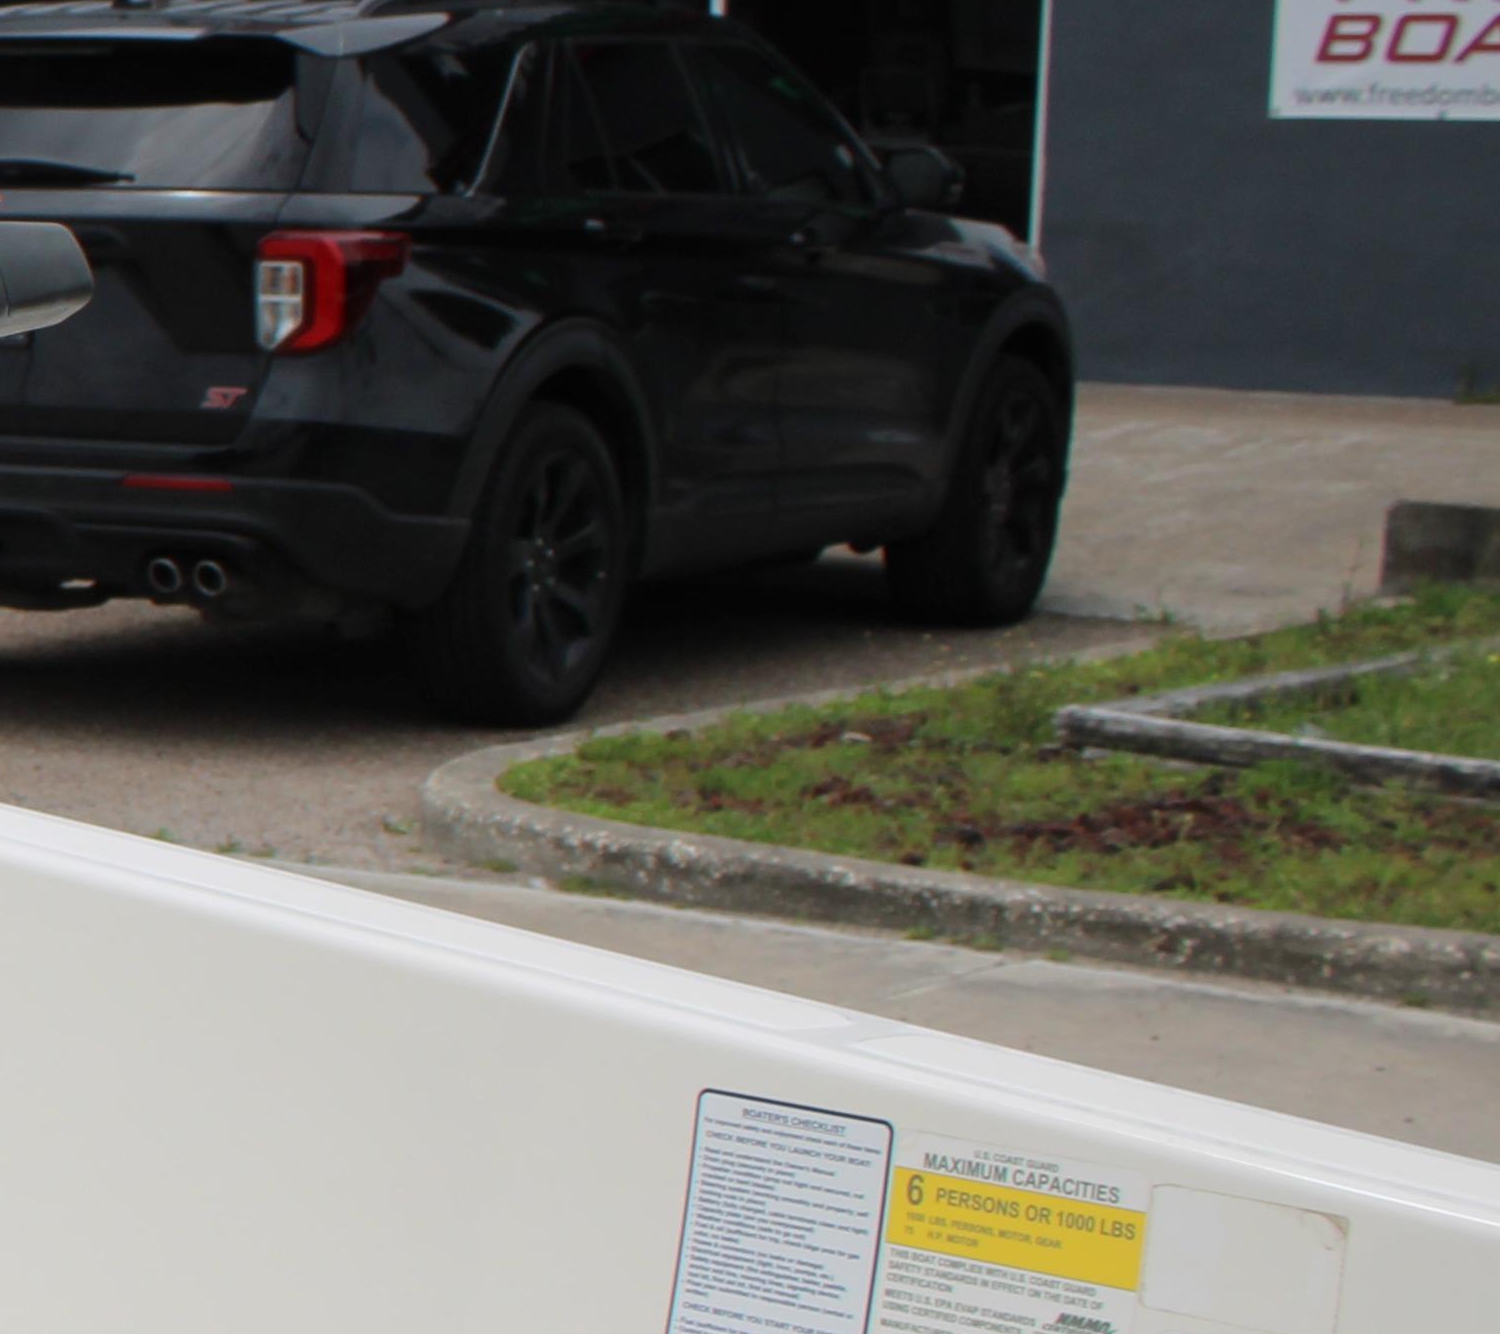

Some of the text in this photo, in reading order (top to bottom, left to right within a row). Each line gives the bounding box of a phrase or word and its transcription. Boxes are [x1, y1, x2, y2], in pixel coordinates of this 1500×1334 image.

[201, 386, 248, 408] ST
[789, 1116, 846, 1135] CHECKLIST
[922, 1150, 1121, 1205] MAXIMUM CAPACITIES
[904, 1172, 926, 1206] 6
[935, 1186, 1021, 1218] PERSONS
[1024, 1203, 1052, 1225] OR
[1056, 1209, 1096, 1233] 1000
[1099, 1217, 1137, 1241] LBS
